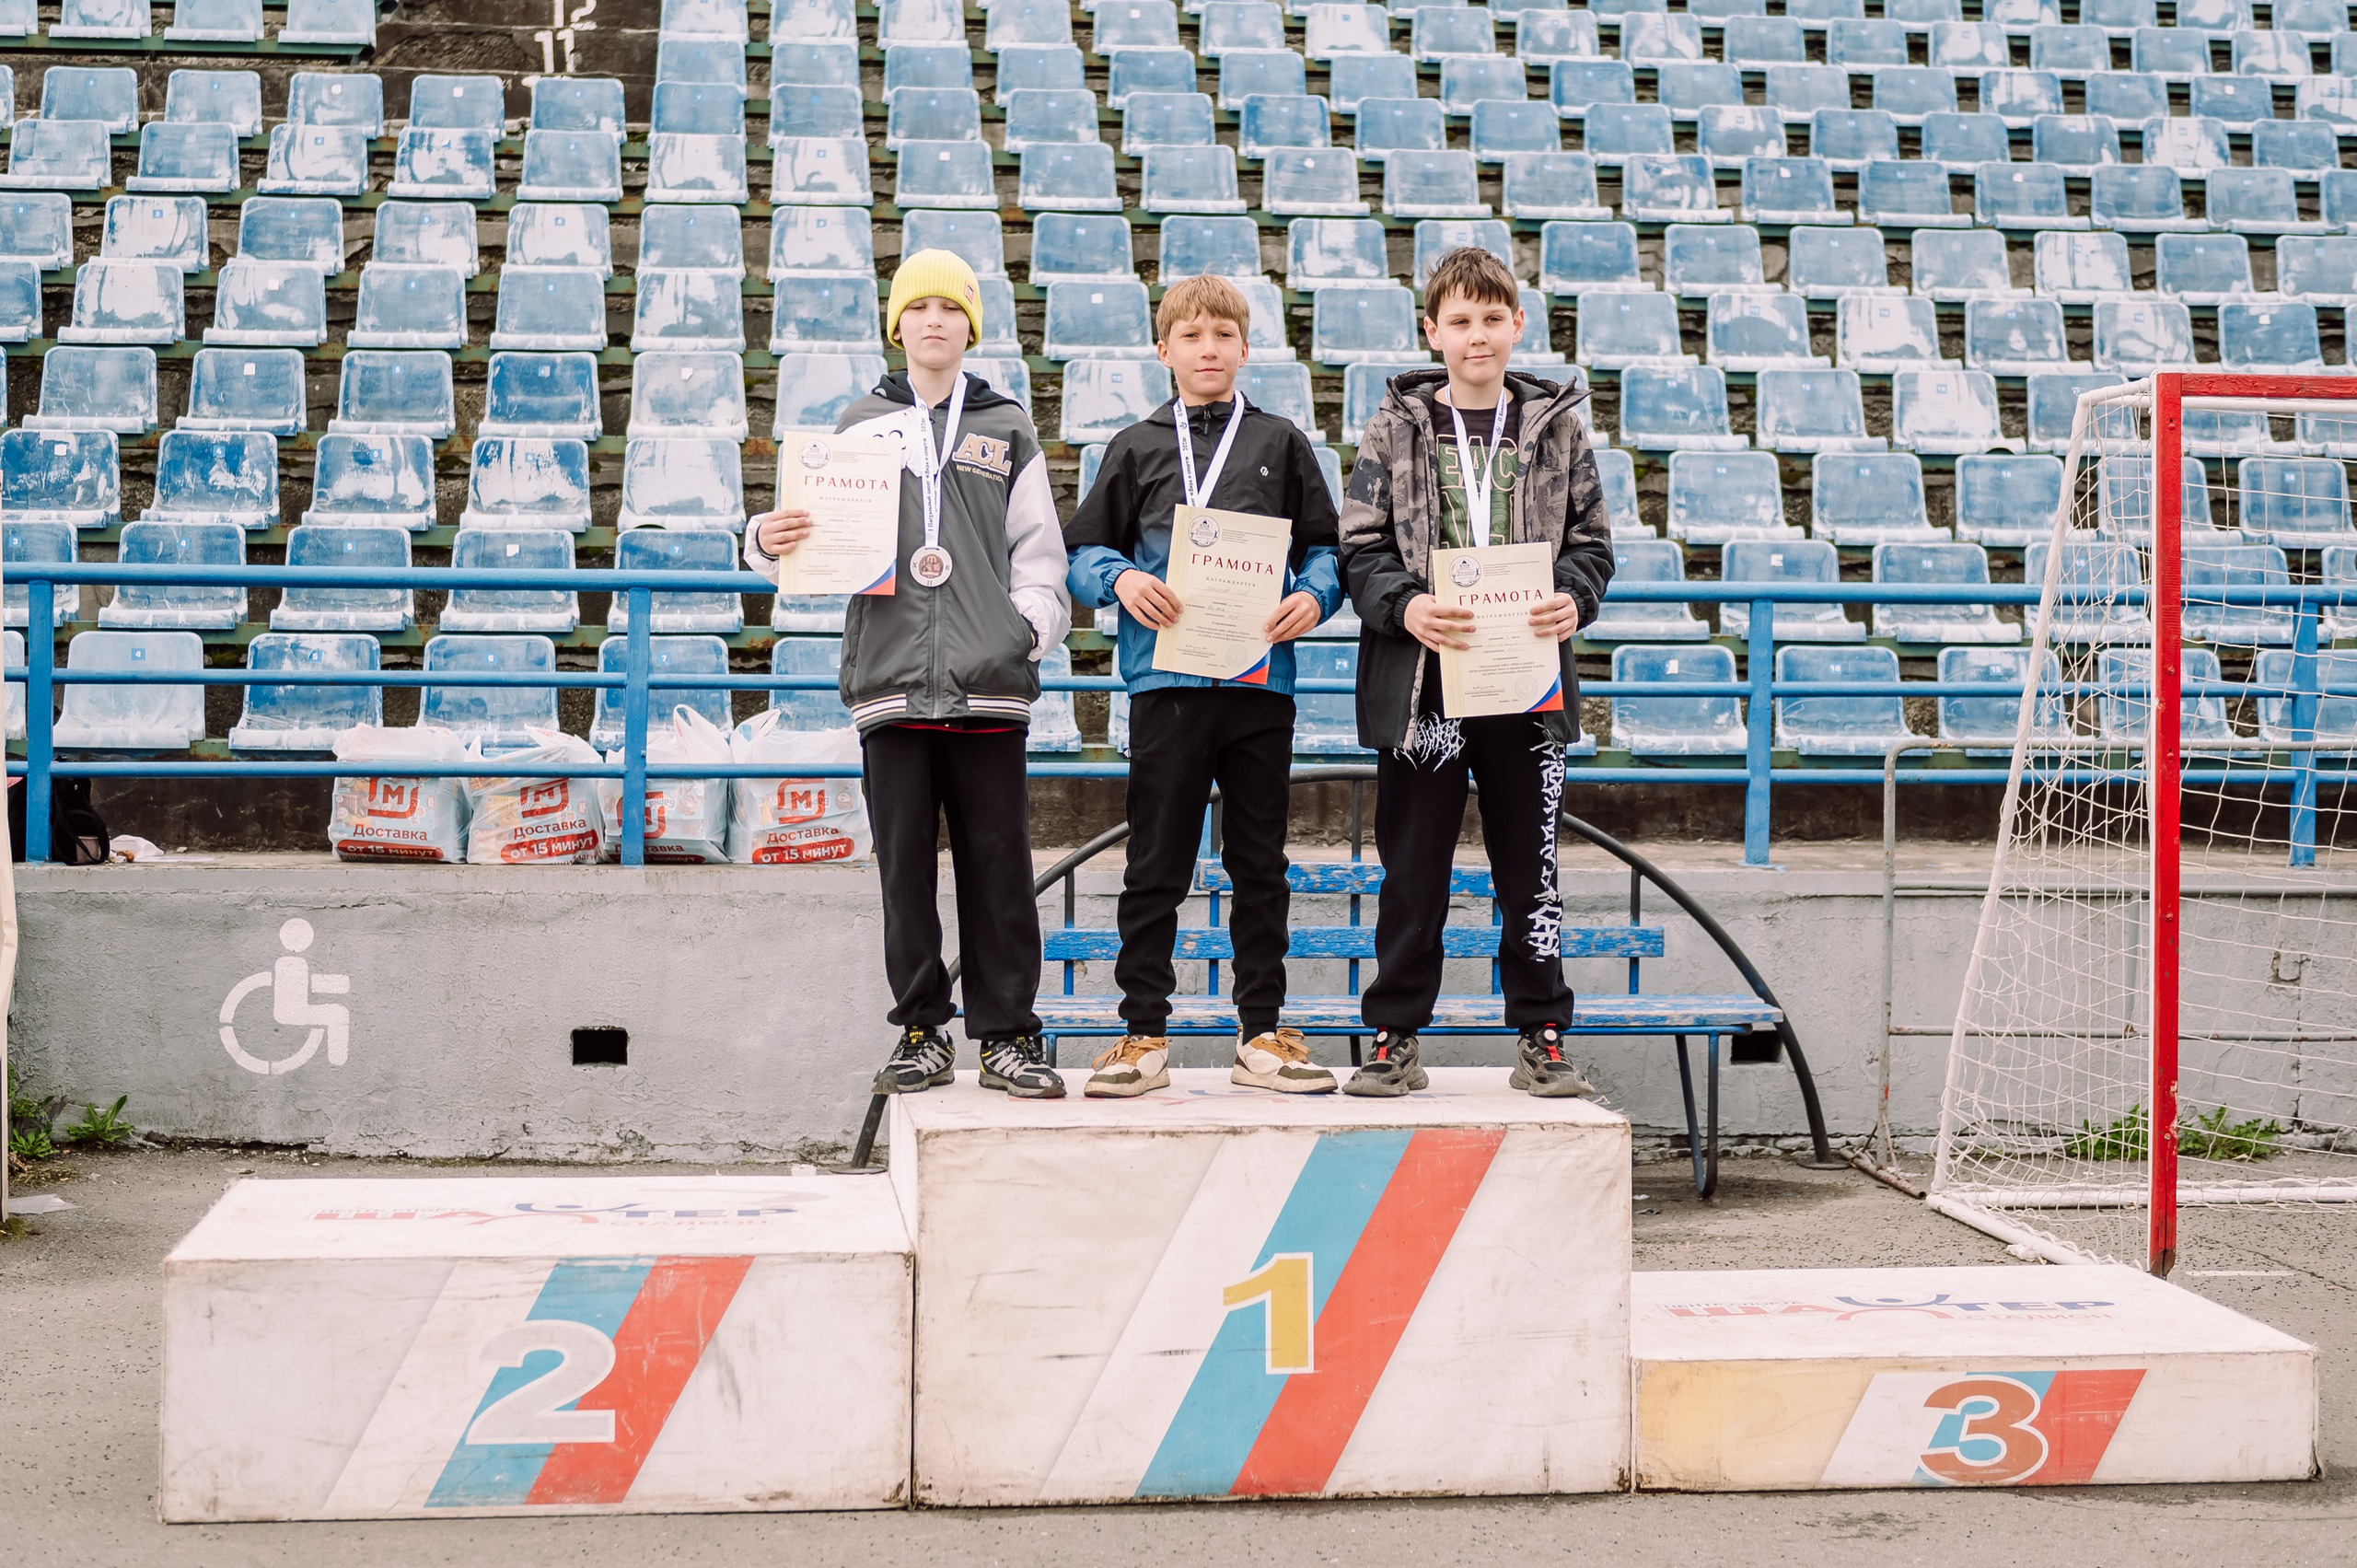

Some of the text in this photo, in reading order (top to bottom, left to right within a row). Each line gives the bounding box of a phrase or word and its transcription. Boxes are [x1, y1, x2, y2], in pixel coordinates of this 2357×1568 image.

[534, 29, 575, 74] 11
[952, 433, 1012, 476] ACL
[804, 475, 889, 491] ГРАМОТА
[957, 464, 1004, 482] NEW GENERATIO
[1191, 553, 1274, 575] ГРАМОТА
[1458, 588, 1544, 607] ГРАМОТА
[383, 784, 405, 805] М
[790, 790, 812, 809] М
[353, 823, 428, 842] Доставка
[514, 819, 587, 841] Доставка
[767, 828, 840, 844] Доставка
[367, 845, 385, 854] 15
[389, 848, 435, 857] минут
[510, 836, 595, 859] от 15 минут
[614, 844, 685, 854] Дтавка
[761, 843, 847, 864] от 15 минут
[1223, 1252, 1315, 1375] 1
[466, 1318, 617, 1445] 2
[1919, 1374, 2049, 1484] 3
